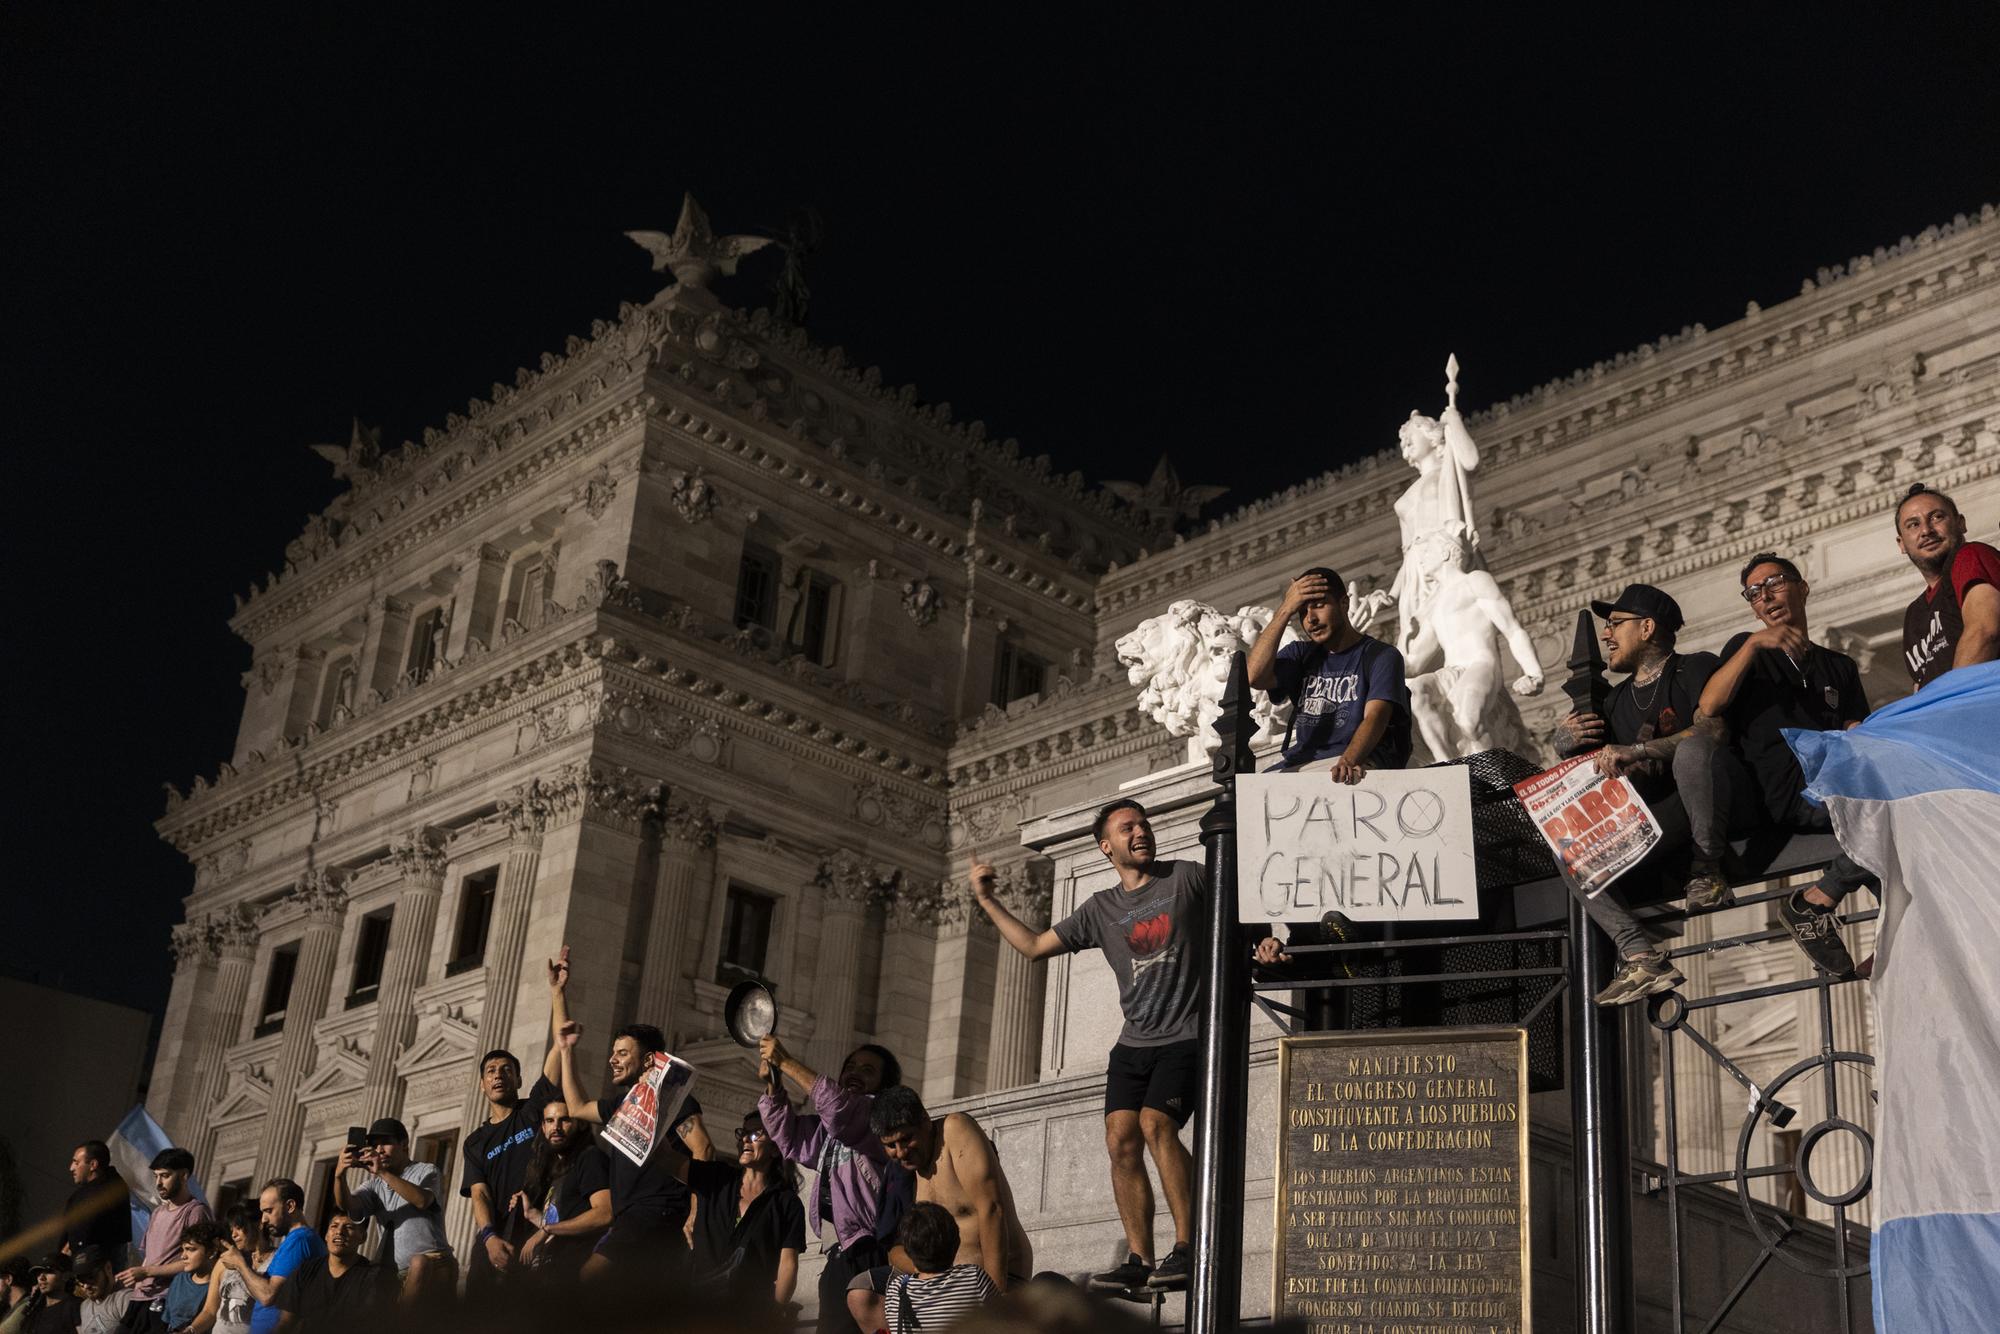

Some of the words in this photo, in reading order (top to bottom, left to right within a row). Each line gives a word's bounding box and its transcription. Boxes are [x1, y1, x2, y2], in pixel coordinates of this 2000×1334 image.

[1527, 784, 1537, 794] 20
[1536, 771, 1559, 789] TODOS
[1559, 766, 1565, 775] A
[1264, 789, 1447, 847] PARO
[1542, 779, 1630, 847] PARO
[1259, 851, 1464, 917] GENERAL
[1348, 1054, 1457, 1077] MANIFIESTO
[1307, 1083, 1326, 1101] EL
[1334, 1080, 1417, 1101] CONGRESO
[1426, 1078, 1498, 1099] GENERAL
[1291, 1105, 1400, 1128] CONSTITUYENTE
[1405, 1105, 1415, 1124] A
[1420, 1104, 1448, 1125] LOS
[1452, 1102, 1517, 1124] PUEBLOS
[1312, 1133, 1331, 1153] DE
[1341, 1132, 1359, 1152] LA
[1368, 1129, 1493, 1151] CONFEDERACION
[1293, 1169, 1316, 1186] LOS
[1321, 1168, 1378, 1185] PUEBLOS
[1383, 1167, 1464, 1185] ARGENTINOS
[1470, 1166, 1513, 1184] ESTAN
[1293, 1189, 1370, 1207] DESTINADOS
[1374, 1189, 1399, 1206] POR
[1404, 1188, 1421, 1205] LA
[1427, 1187, 1511, 1205] PROVIDENCIA
[1289, 1211, 1298, 1228] A
[1302, 1211, 1327, 1227] SER
[1331, 1210, 1384, 1227] FELICES
[1388, 1210, 1411, 1227] SIN
[1416, 1210, 1446, 1226] MAS
[1449, 1208, 1517, 1226] CONDICION
[1306, 1231, 1332, 1249] QUE
[1338, 1232, 1354, 1249] LA
[1362, 1232, 1377, 1248] DE
[1384, 1231, 1425, 1248] VIVIR
[1432, 1231, 1450, 1248] EN
[1457, 1230, 1483, 1247] PAZ
[1489, 1230, 1498, 1248] Y
[1318, 1255, 1400, 1271] SOMETIDOS
[1408, 1254, 1418, 1271] A
[1429, 1254, 1448, 1272] LA
[1289, 1278, 1320, 1294] ESTE
[1325, 1278, 1349, 1294] FUE
[1353, 1278, 1370, 1294] EL
[1374, 1278, 1487, 1296] CONVENCIMIENTO
[1298, 1301, 1362, 1318] CONGRESO
[1370, 1301, 1420, 1318] CUANDO
[1427, 1301, 1444, 1318] SE
[1452, 1301, 1508, 1318] DECIDIO
